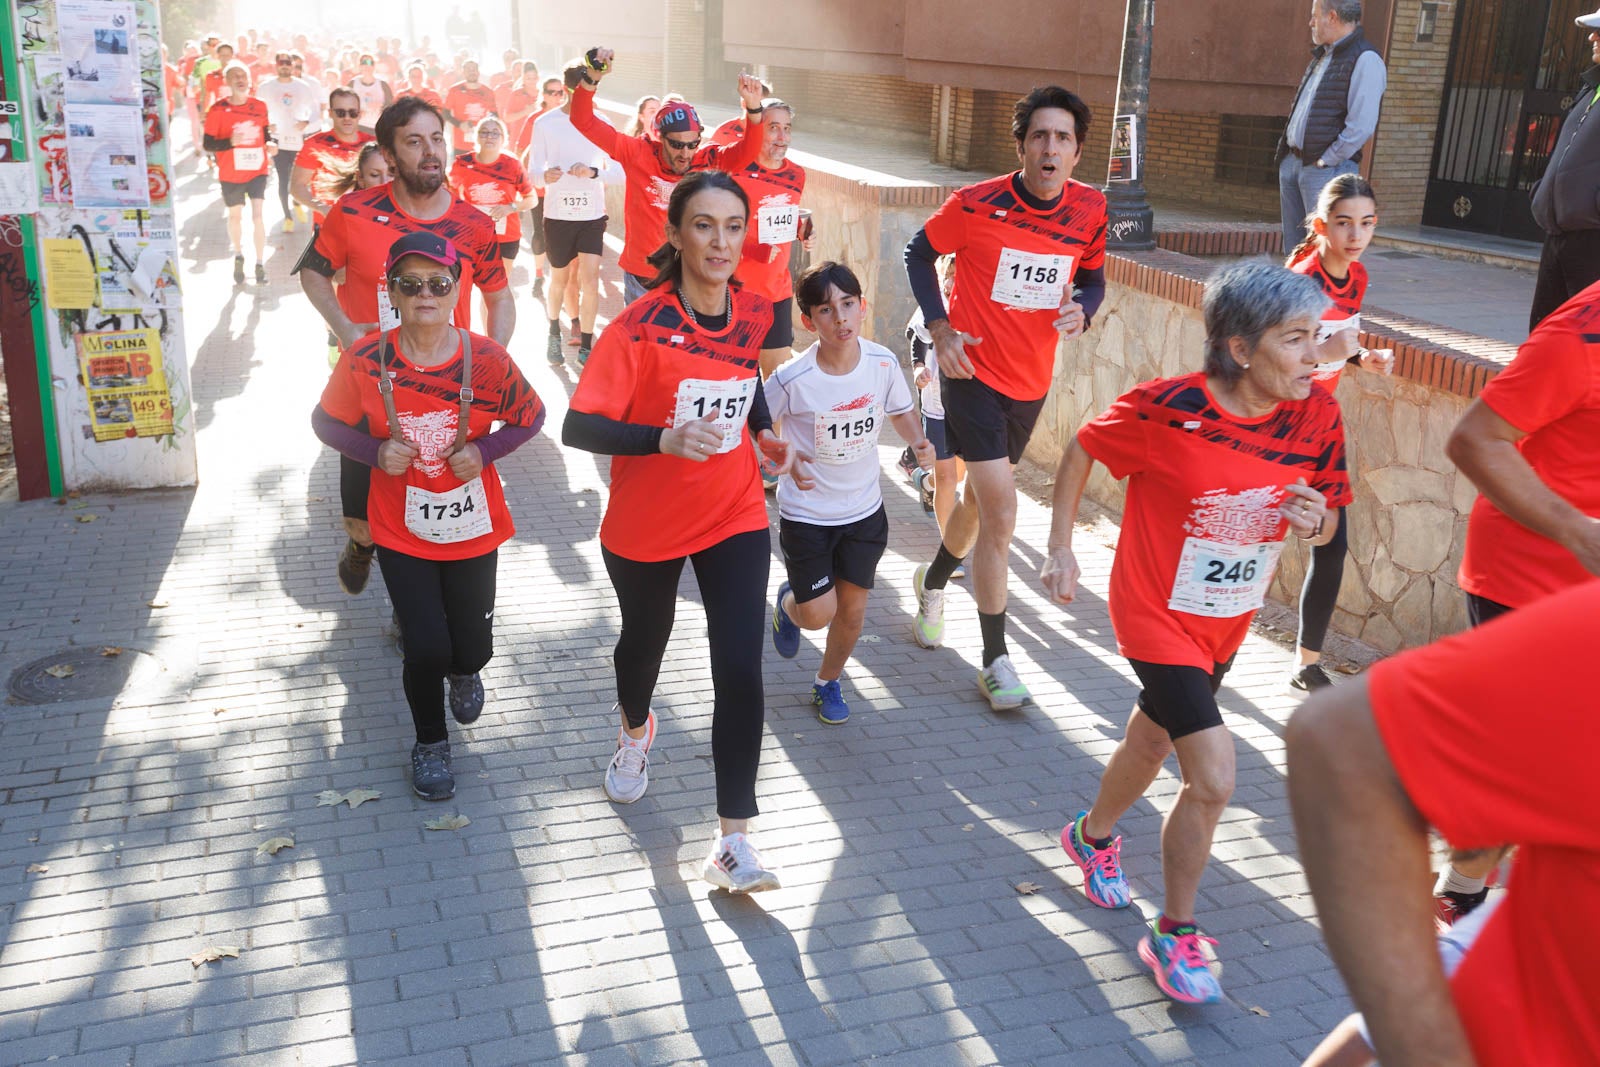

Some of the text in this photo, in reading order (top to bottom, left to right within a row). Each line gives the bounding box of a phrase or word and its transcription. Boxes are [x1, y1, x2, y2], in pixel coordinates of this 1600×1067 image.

[563, 197, 588, 206] 1373
[766, 214, 792, 227] 1440
[1010, 263, 1058, 284] 1158
[88, 336, 147, 351] MOLINA
[129, 353, 153, 377] B
[133, 400, 155, 412] 149
[693, 396, 747, 418] 1157
[827, 417, 874, 440] 1159
[419, 495, 475, 520] 1734
[1204, 559, 1257, 583] 246
[1204, 586, 1228, 594] SUPER
